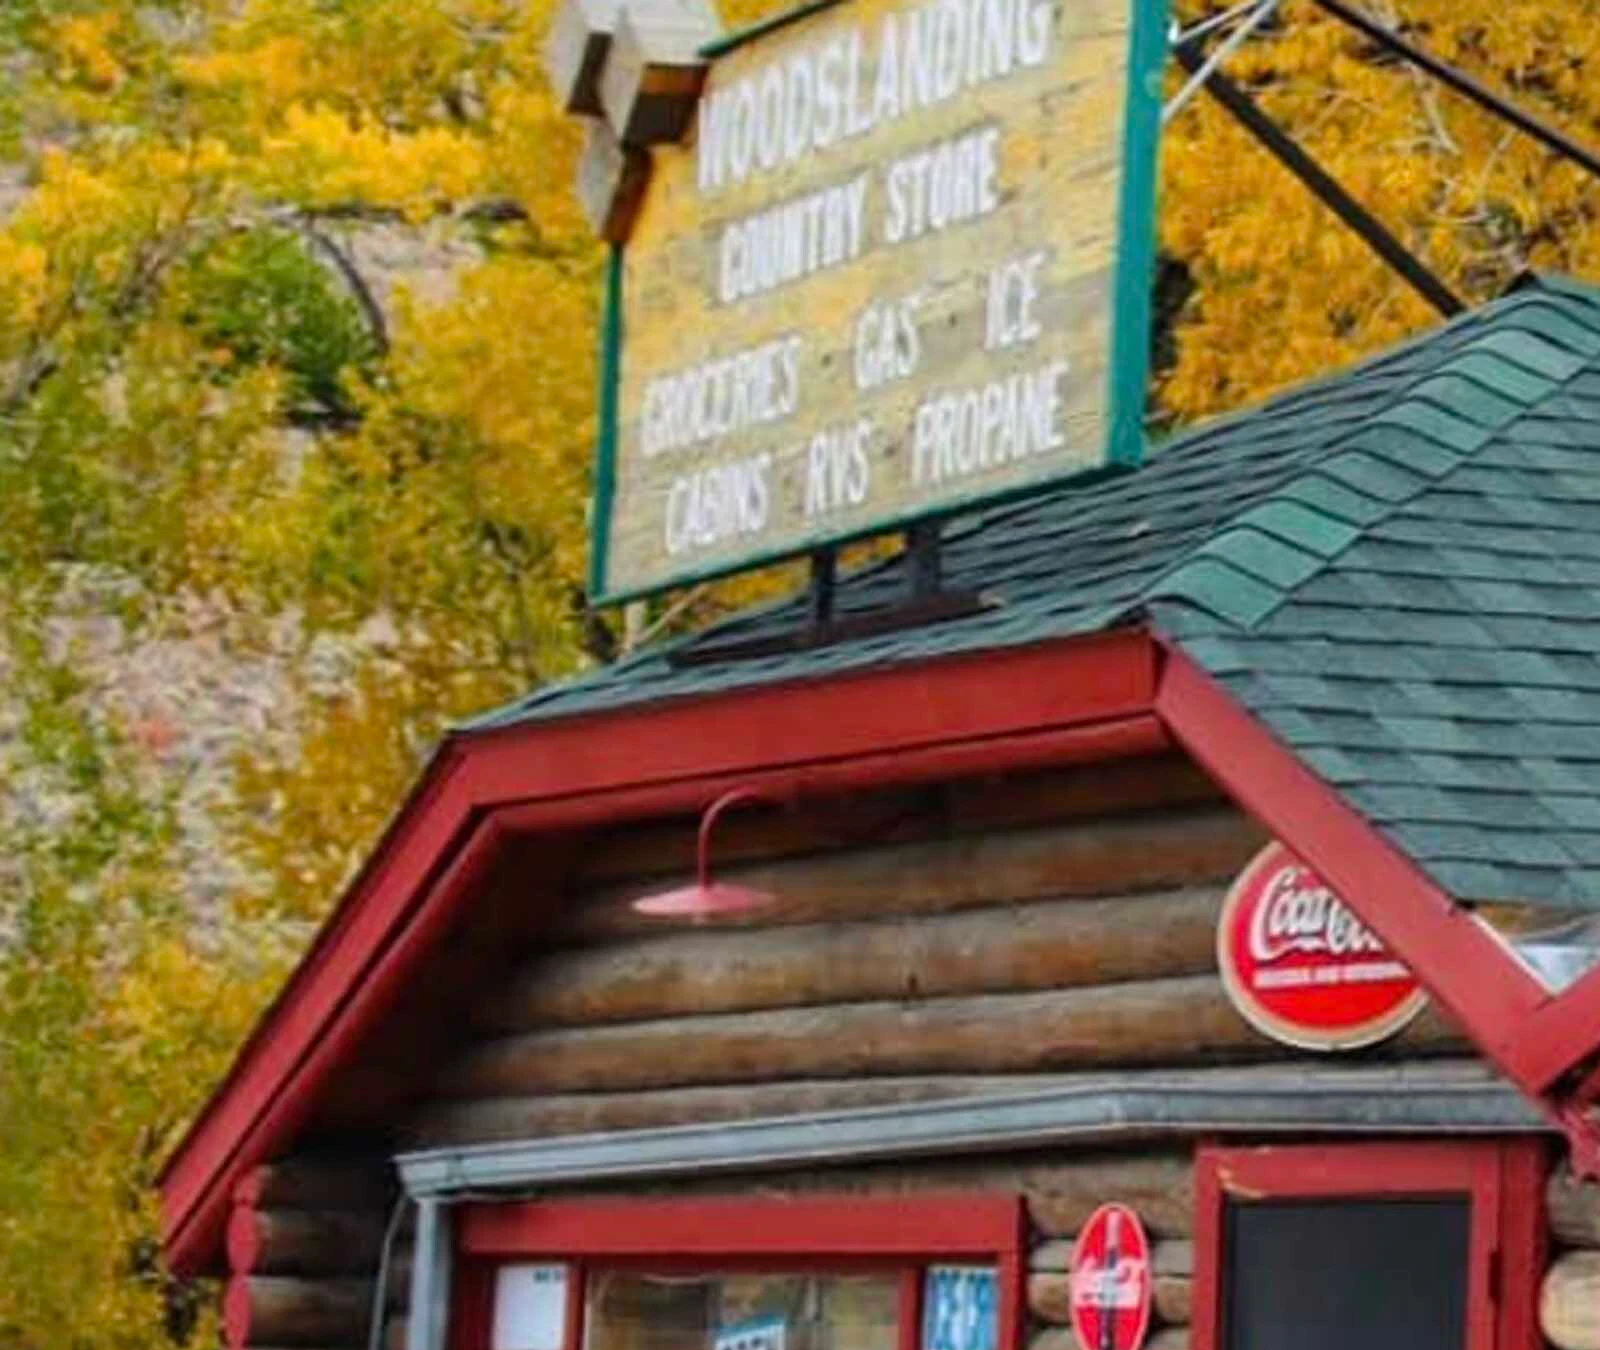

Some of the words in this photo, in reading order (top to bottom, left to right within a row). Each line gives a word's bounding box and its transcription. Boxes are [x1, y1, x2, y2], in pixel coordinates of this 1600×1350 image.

[719, 168, 869, 302] COUNTRY
[883, 126, 1000, 242] STORE
[640, 335, 801, 456] GROCERIES
[855, 295, 922, 390] GAS
[983, 251, 1047, 351] ICE
[665, 452, 772, 553] CABINS
[910, 360, 1071, 488] PROPANE
